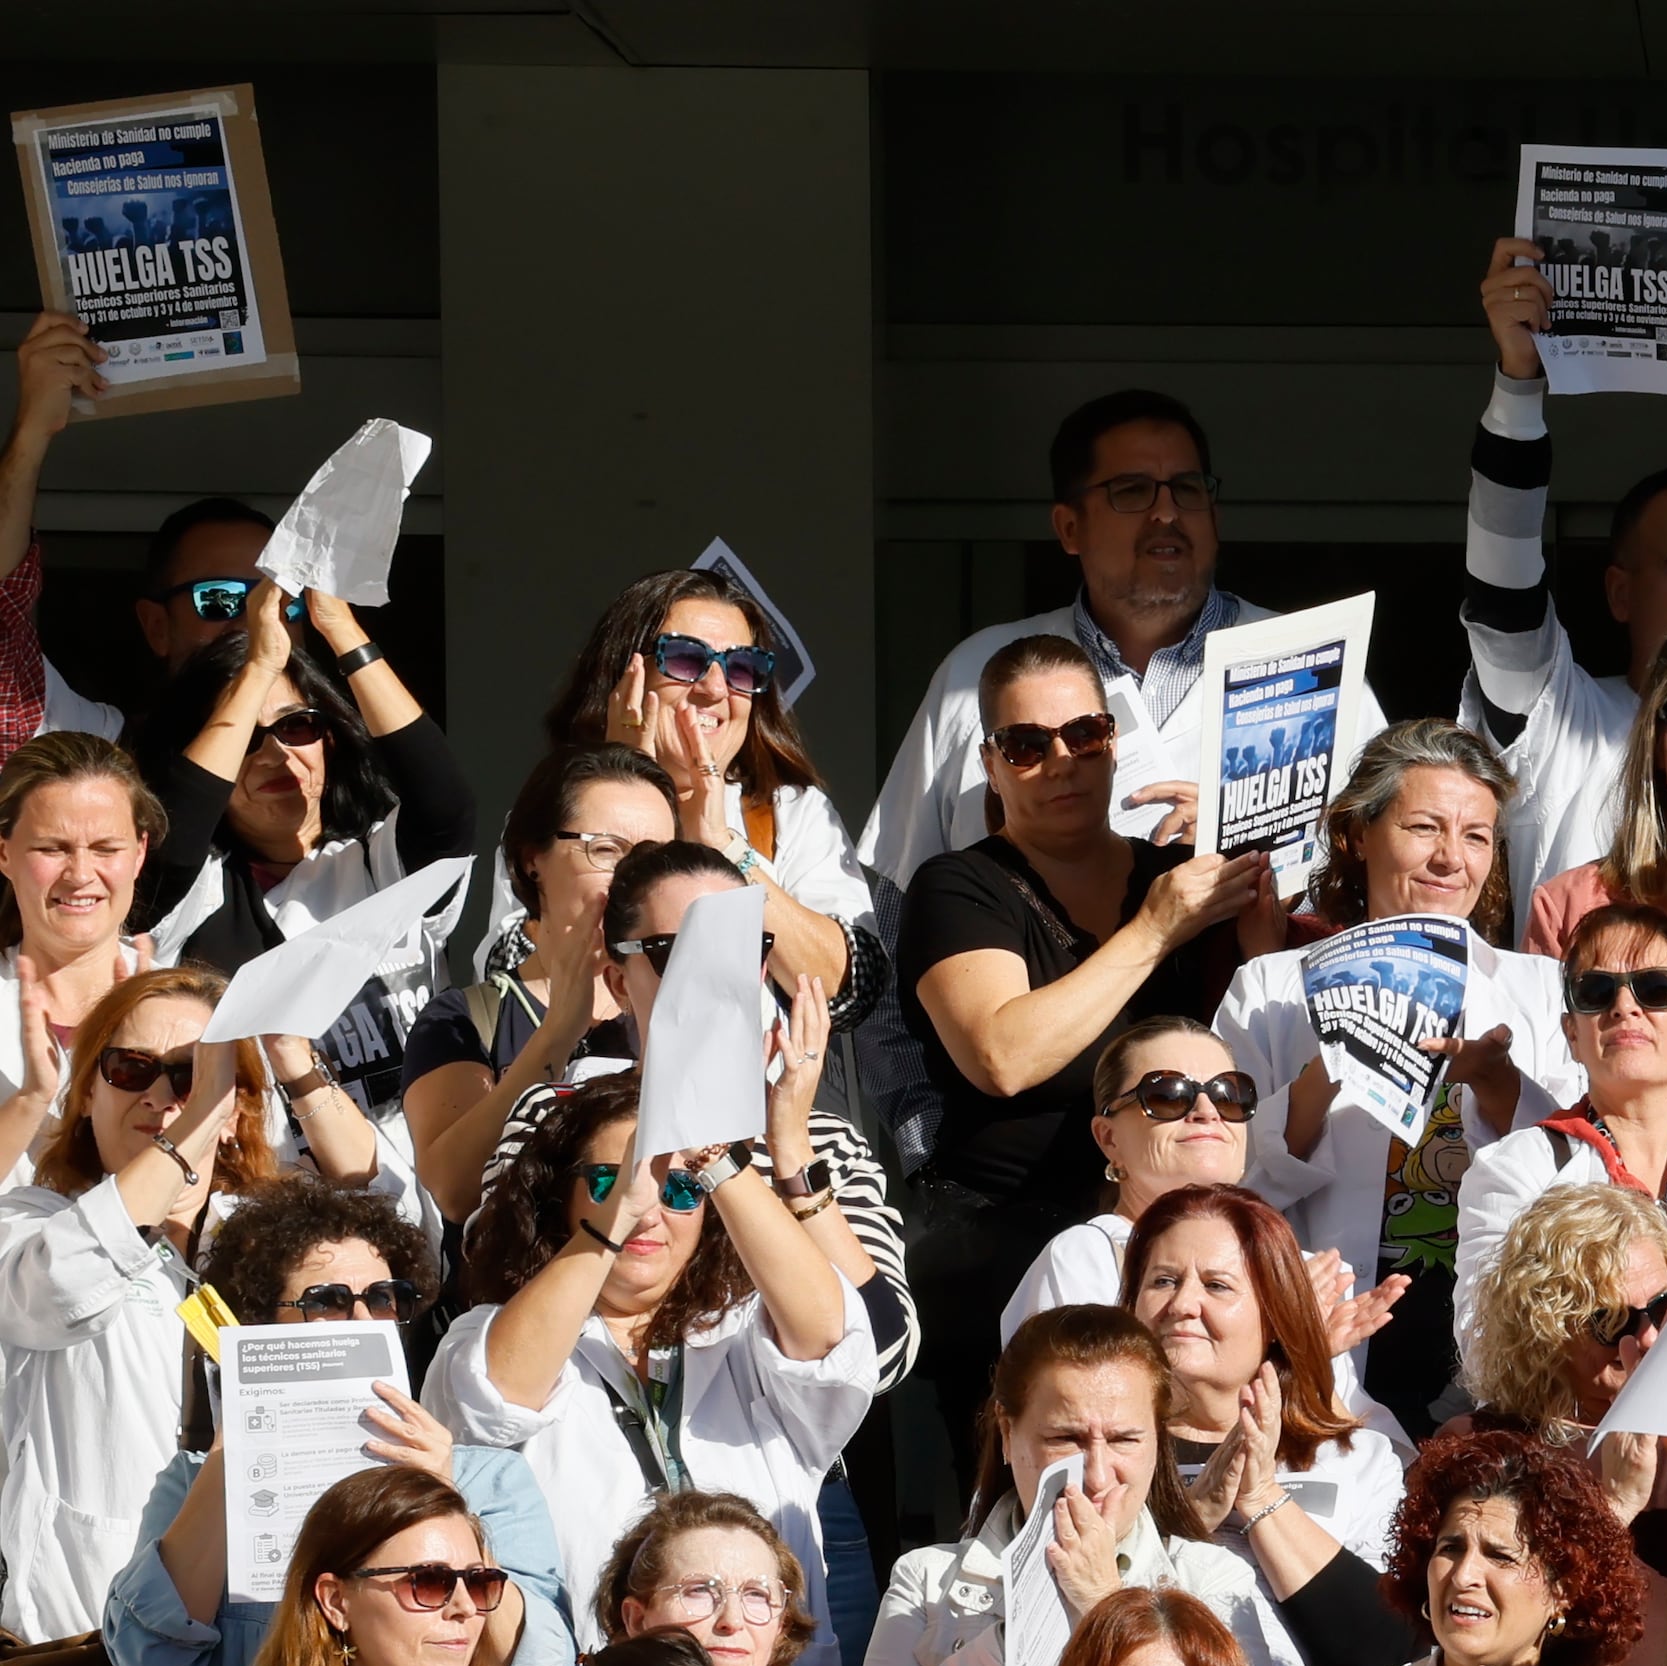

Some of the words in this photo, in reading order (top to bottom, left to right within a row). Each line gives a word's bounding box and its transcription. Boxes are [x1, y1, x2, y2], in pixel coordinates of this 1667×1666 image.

[48, 127, 99, 150] Ministerio
[102, 128, 114, 144] de
[116, 127, 156, 142] Sanidad
[158, 130, 171, 141] no
[174, 123, 211, 140] cumple
[52, 156, 100, 176] Hacienda
[103, 155, 117, 170] no
[119, 151, 145, 168] paga
[1541, 166, 1581, 182] Ministerio
[1583, 170, 1594, 182] de
[1595, 170, 1628, 185] Sanidad
[1630, 175, 1641, 185] no
[67, 177, 122, 196] Consejerías
[124, 176, 135, 191] de
[137, 173, 163, 190] Salud
[164, 174, 181, 188] nos
[183, 171, 219, 190] ignoran
[1540, 189, 1579, 202] Hacienda
[1581, 192, 1592, 202] no
[1594, 191, 1615, 203] paga
[68, 244, 176, 296] HUELGA
[179, 236, 233, 282] TSS
[76, 293, 122, 311] Técnicos
[124, 287, 181, 307] Superiores
[183, 282, 235, 299] Sanitarios
[1539, 264, 1624, 301] HUELGA
[1222, 766, 1290, 824] HUELGA
[1294, 753, 1328, 801] TSS
[1314, 985, 1412, 1036] HUELGA
[1409, 1002, 1449, 1044] TSS
